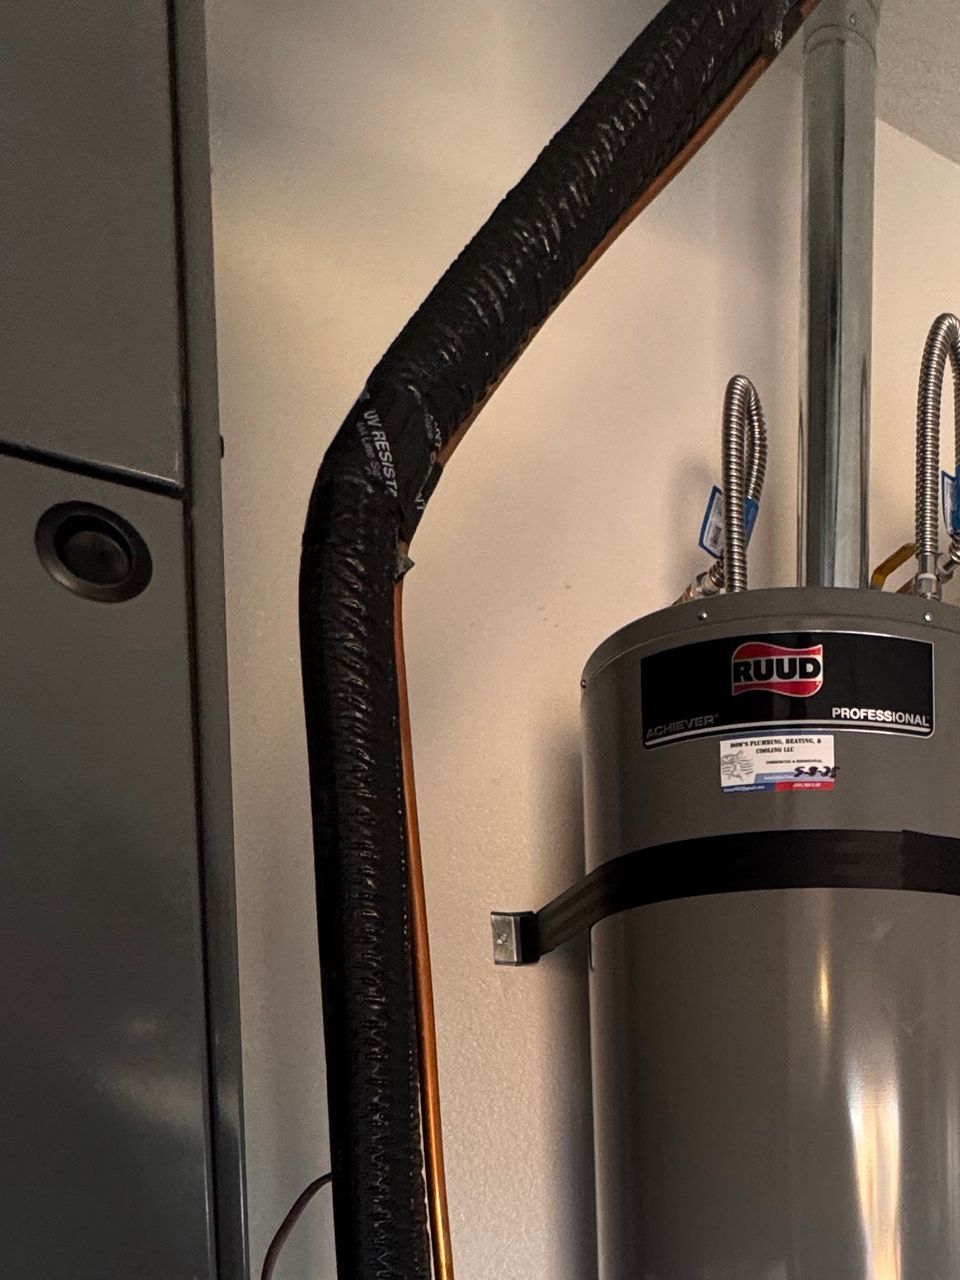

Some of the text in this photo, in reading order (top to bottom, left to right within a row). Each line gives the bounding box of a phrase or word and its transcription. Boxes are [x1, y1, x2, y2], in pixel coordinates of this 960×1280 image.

[733, 656, 822, 683] RUUD
[645, 714, 716, 740] ACHIEVER
[831, 706, 930, 727] PROFESSIONAL
